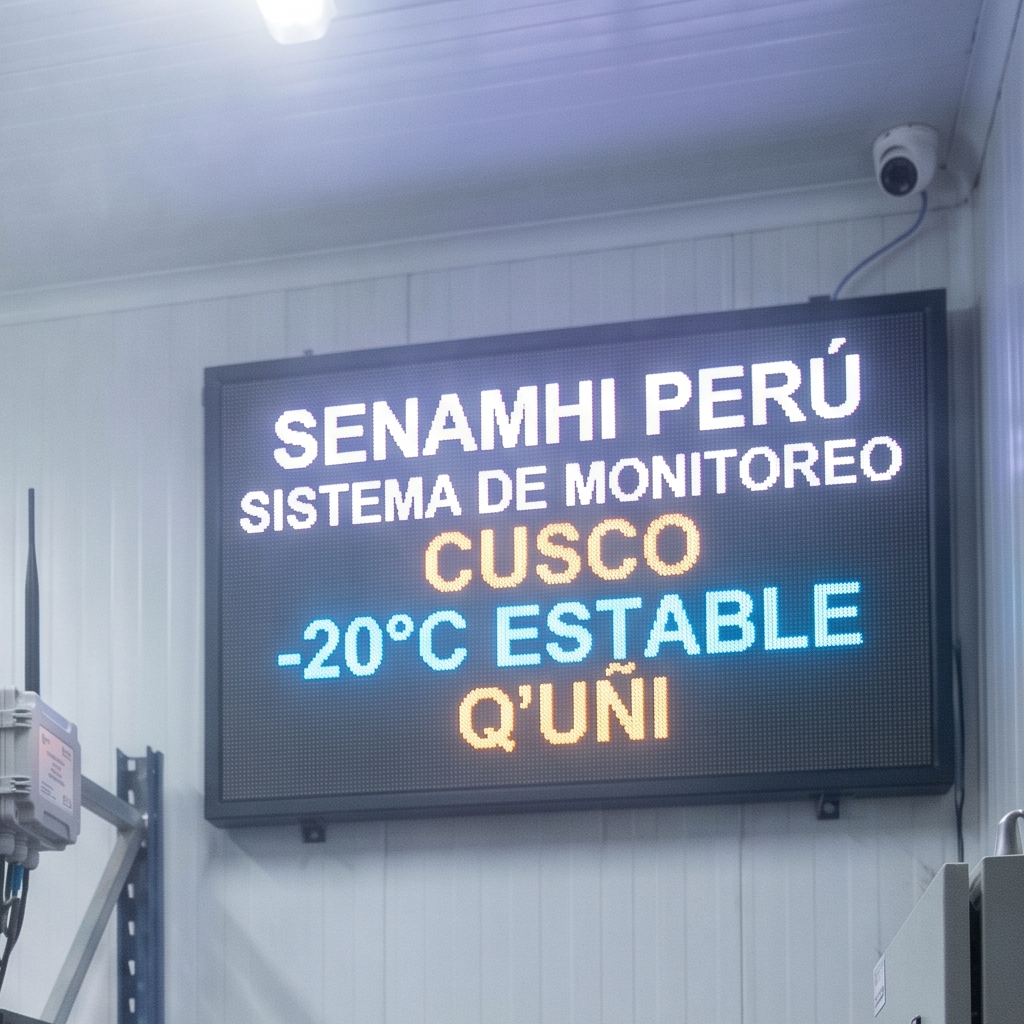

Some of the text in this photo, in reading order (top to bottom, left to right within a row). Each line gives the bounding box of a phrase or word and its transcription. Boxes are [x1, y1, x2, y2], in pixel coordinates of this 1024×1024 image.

[274, 338, 861, 470] SENAMHI PERÚ
[240, 435, 903, 534] SISTEMA DE MONITOREO
[424, 513, 701, 592] CUSCO
[277, 581, 864, 680] -20°C ESTABLE
